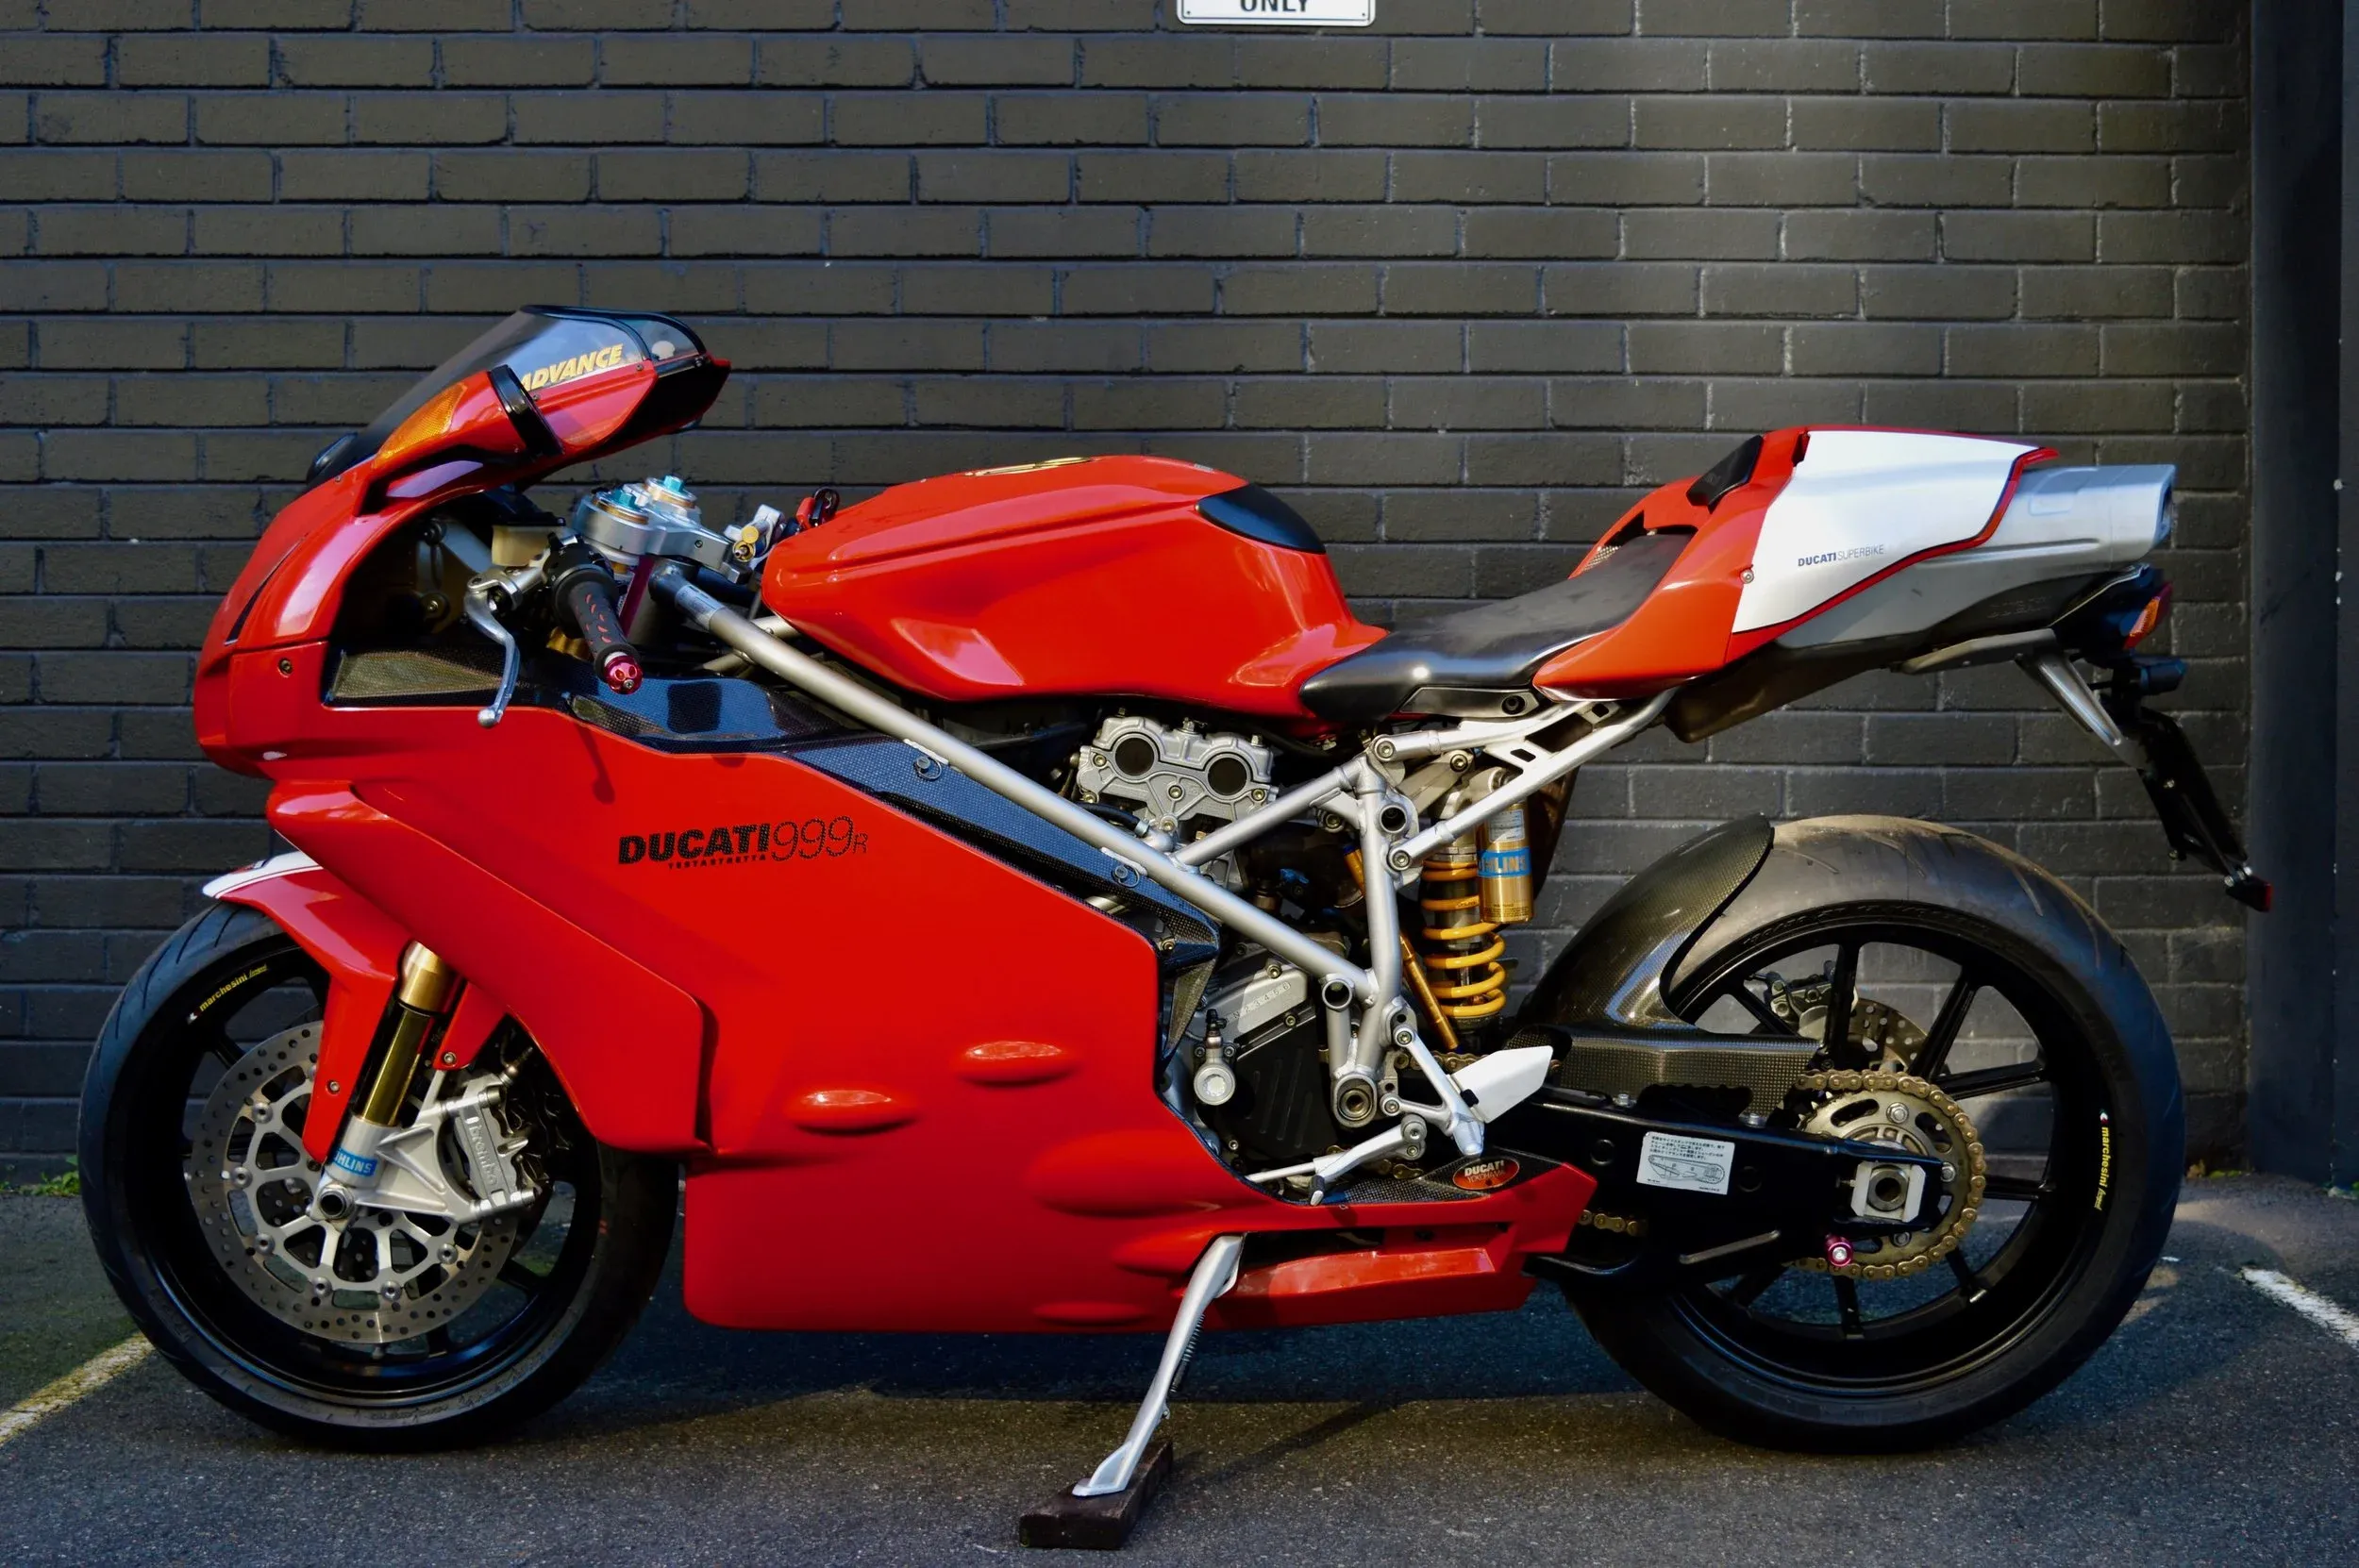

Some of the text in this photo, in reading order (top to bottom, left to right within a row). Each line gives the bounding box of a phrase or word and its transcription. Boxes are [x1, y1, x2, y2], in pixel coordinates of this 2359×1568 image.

[1240, 0, 1308, 12] ONLY
[521, 343, 624, 392] ADVANCE
[1798, 544, 1884, 567] DUCATI SUPERBIKE
[618, 823, 770, 865] DUCATI
[199, 974, 248, 1012] marchesini
[1464, 1159, 1505, 1177] DUCATI
[2100, 1126, 2111, 1188] marchesini
